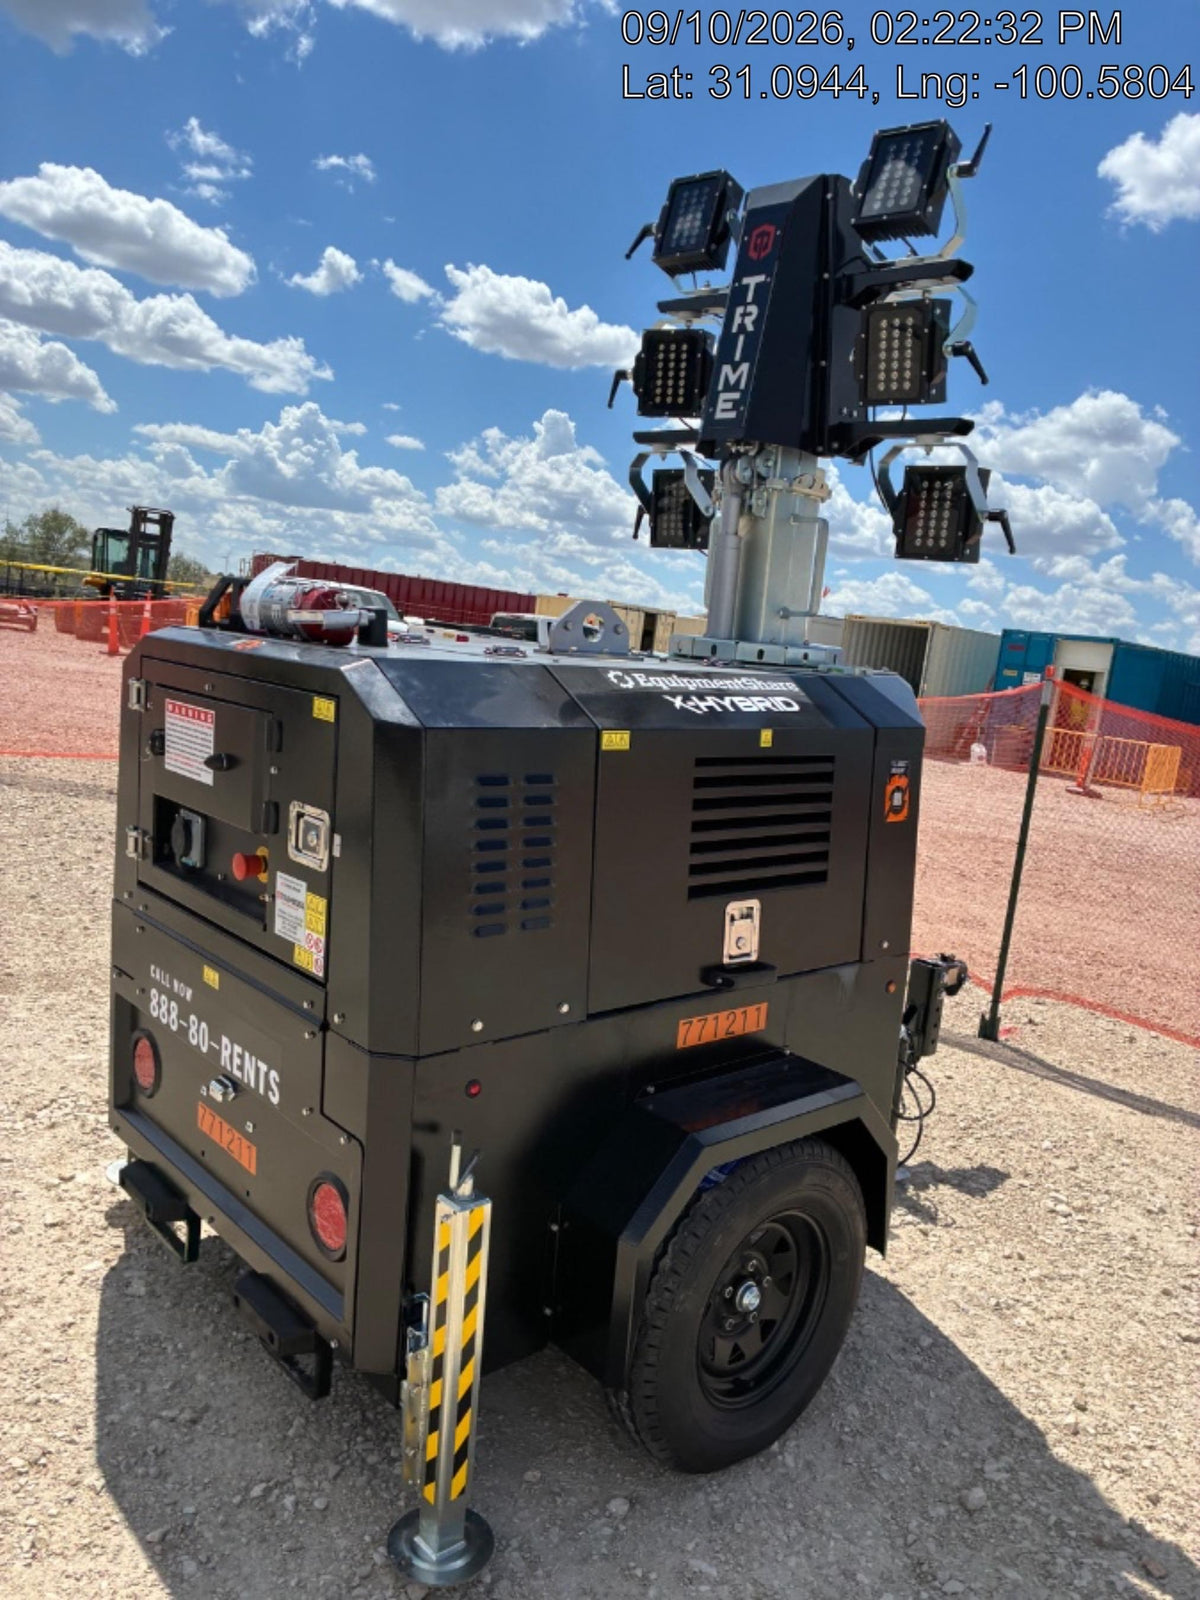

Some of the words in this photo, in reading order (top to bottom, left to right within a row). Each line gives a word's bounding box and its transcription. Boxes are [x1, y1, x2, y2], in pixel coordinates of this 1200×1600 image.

[714, 274, 766, 419] TRIME
[633, 673, 799, 692] EquipmentShare
[150, 964, 171, 988] CALL
[173, 978, 193, 1002] NOW
[149, 987, 280, 1106] 888-80-RENTS
[682, 1007, 762, 1046] 771211
[200, 1108, 255, 1169] 771211
